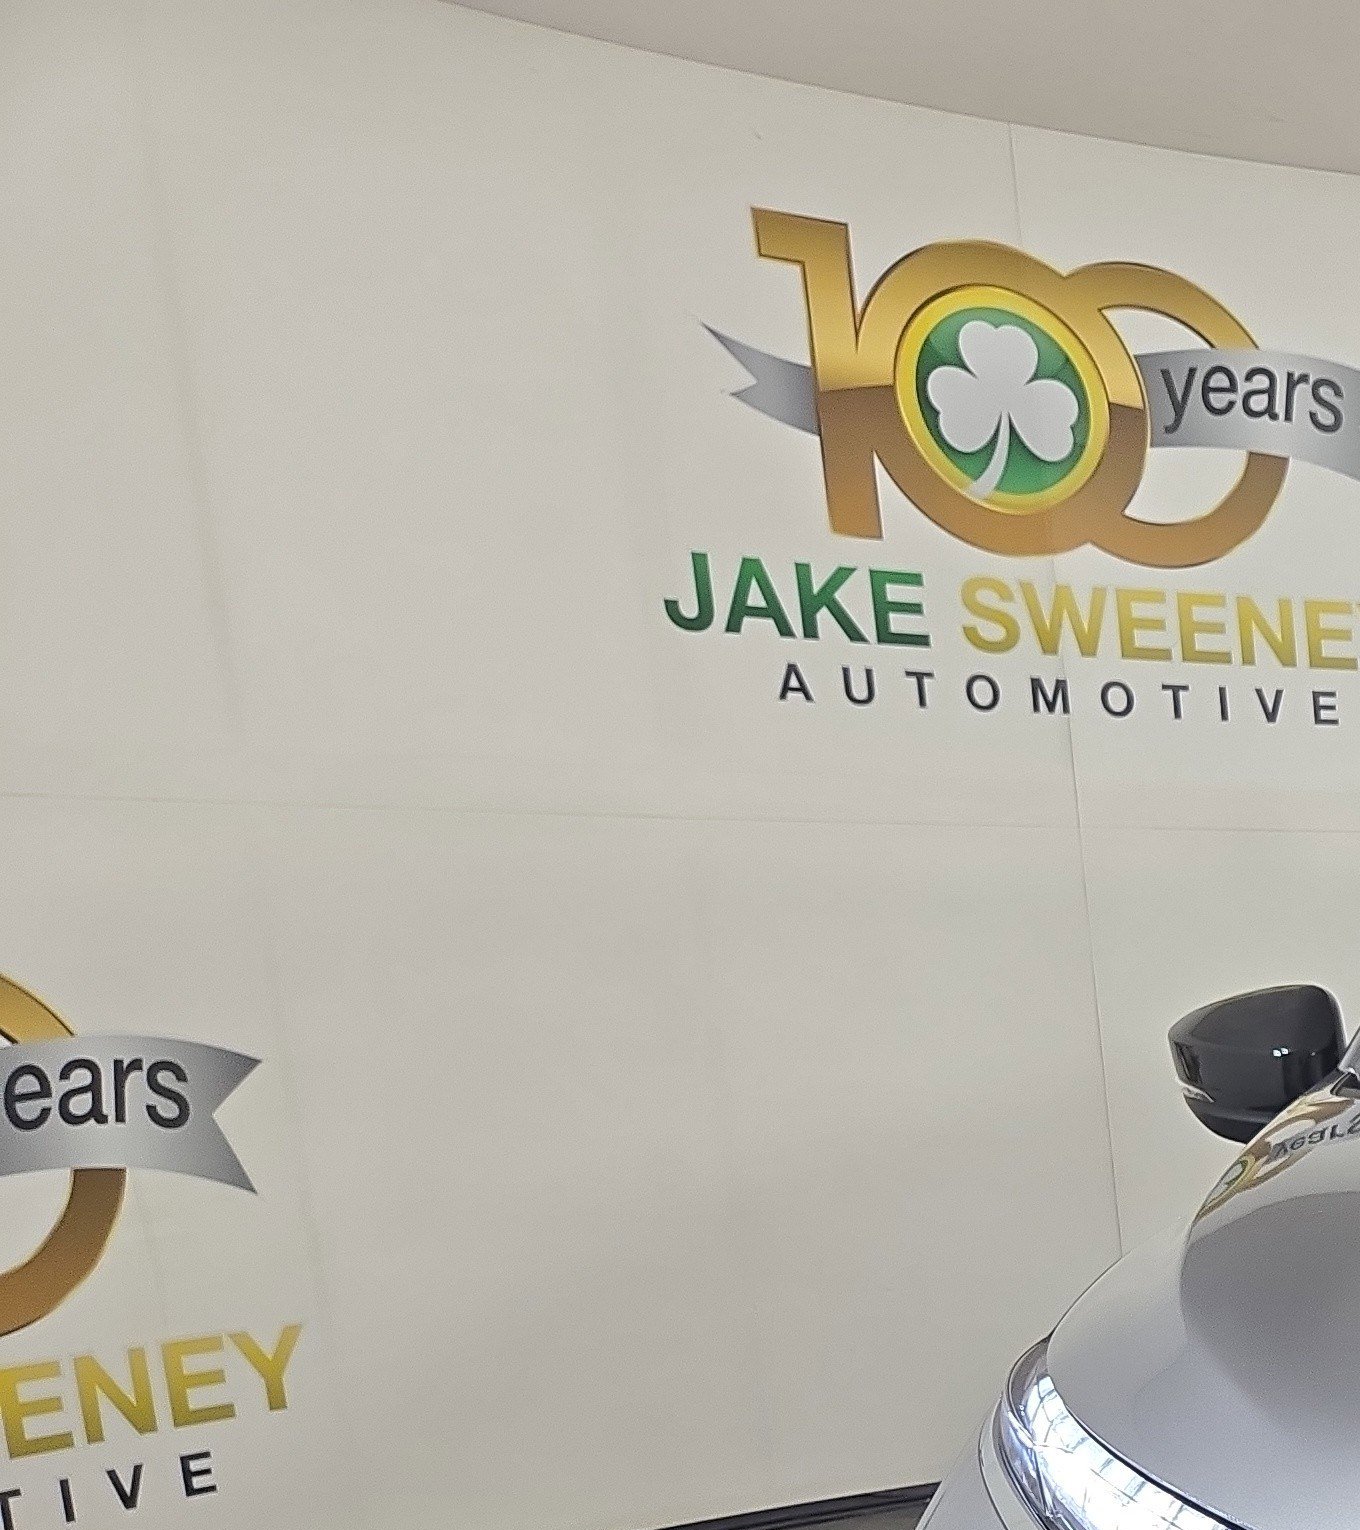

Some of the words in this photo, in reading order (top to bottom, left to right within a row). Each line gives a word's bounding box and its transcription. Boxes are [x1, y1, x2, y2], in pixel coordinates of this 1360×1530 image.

[1159, 364, 1344, 434] years
[663, 550, 931, 648] JAKE
[778, 662, 1340, 726] AUTOMOTIVE
